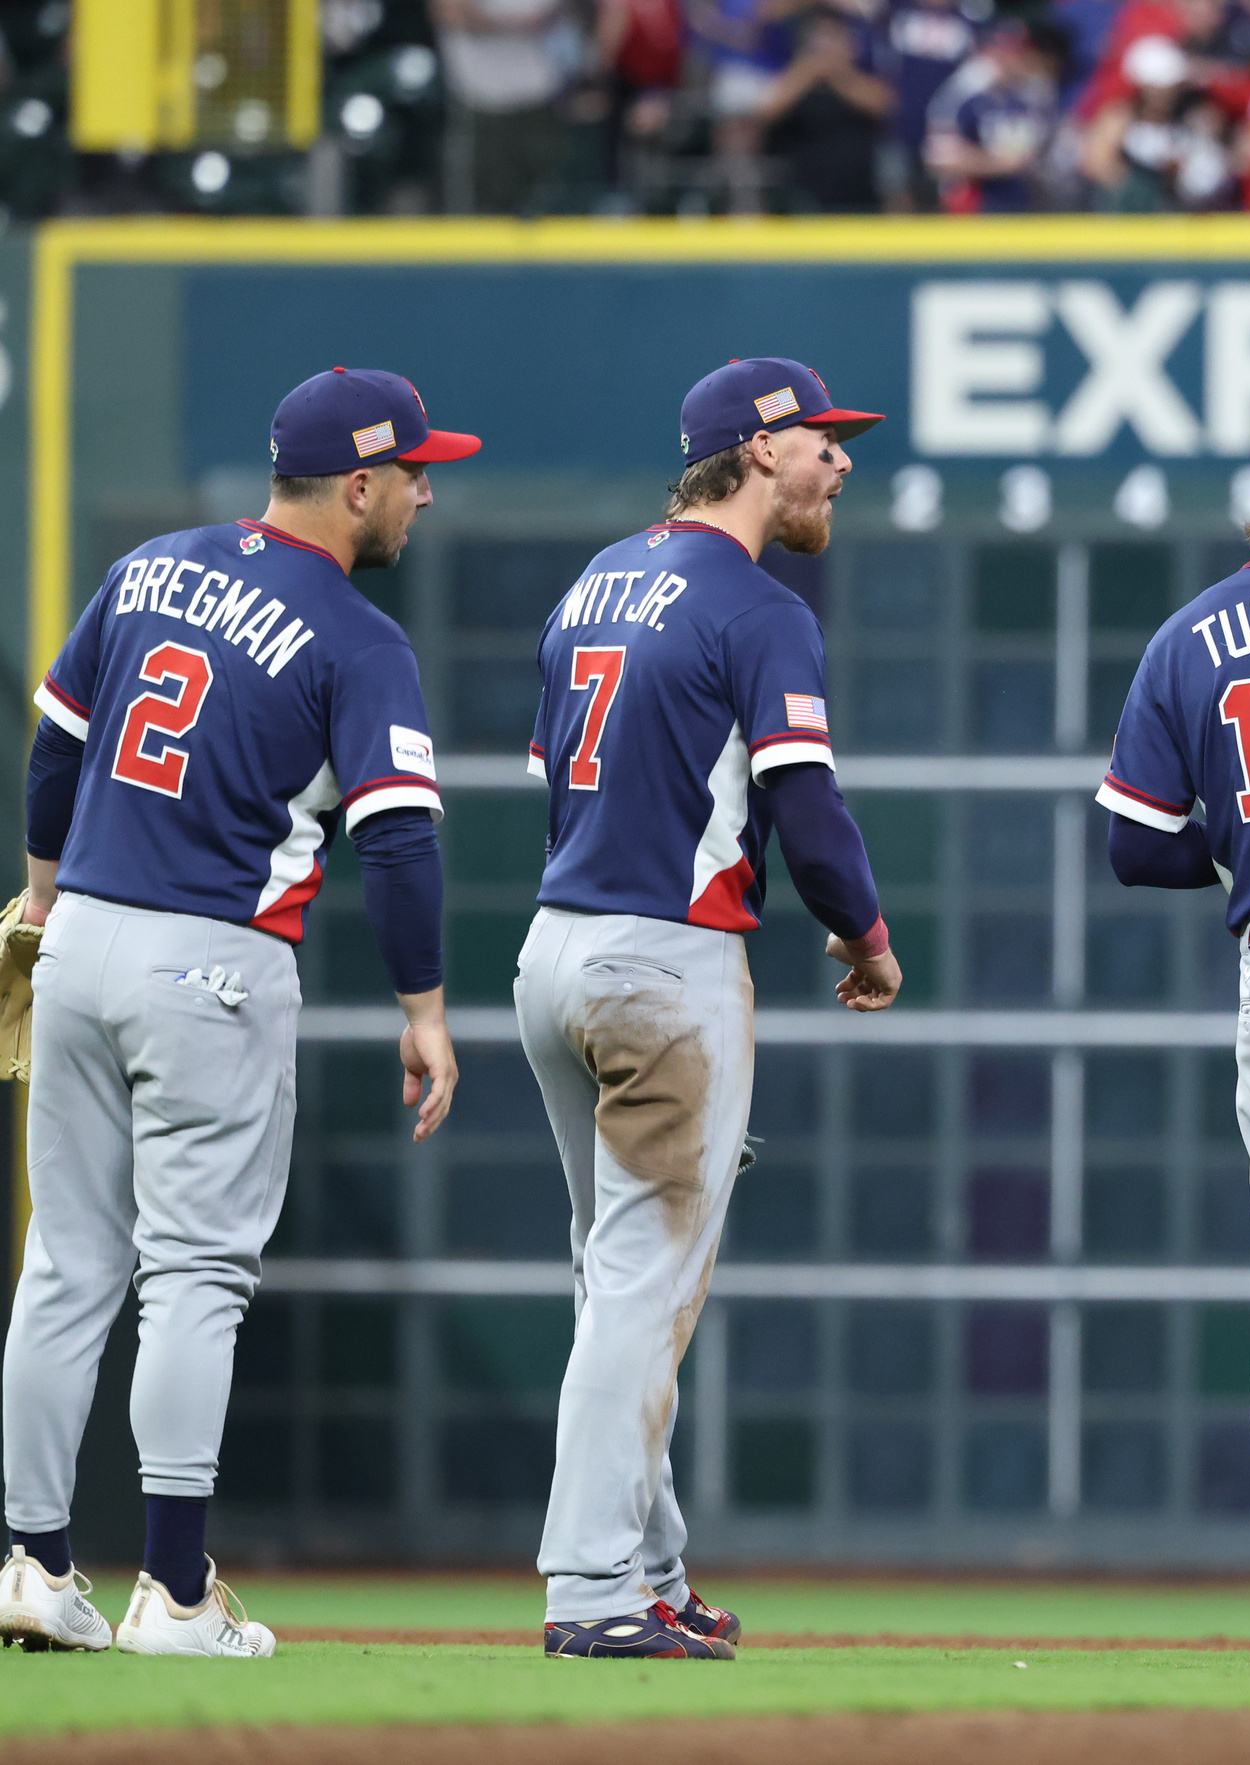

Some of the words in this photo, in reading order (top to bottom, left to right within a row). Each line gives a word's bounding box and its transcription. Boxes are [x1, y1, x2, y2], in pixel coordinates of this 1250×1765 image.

[115, 557, 315, 678] BREGMAN
[561, 571, 644, 630] WITT
[625, 570, 687, 631] JR.
[111, 640, 213, 800] 2
[569, 646, 627, 791] 7
[221, 1640, 251, 1653] marucci
